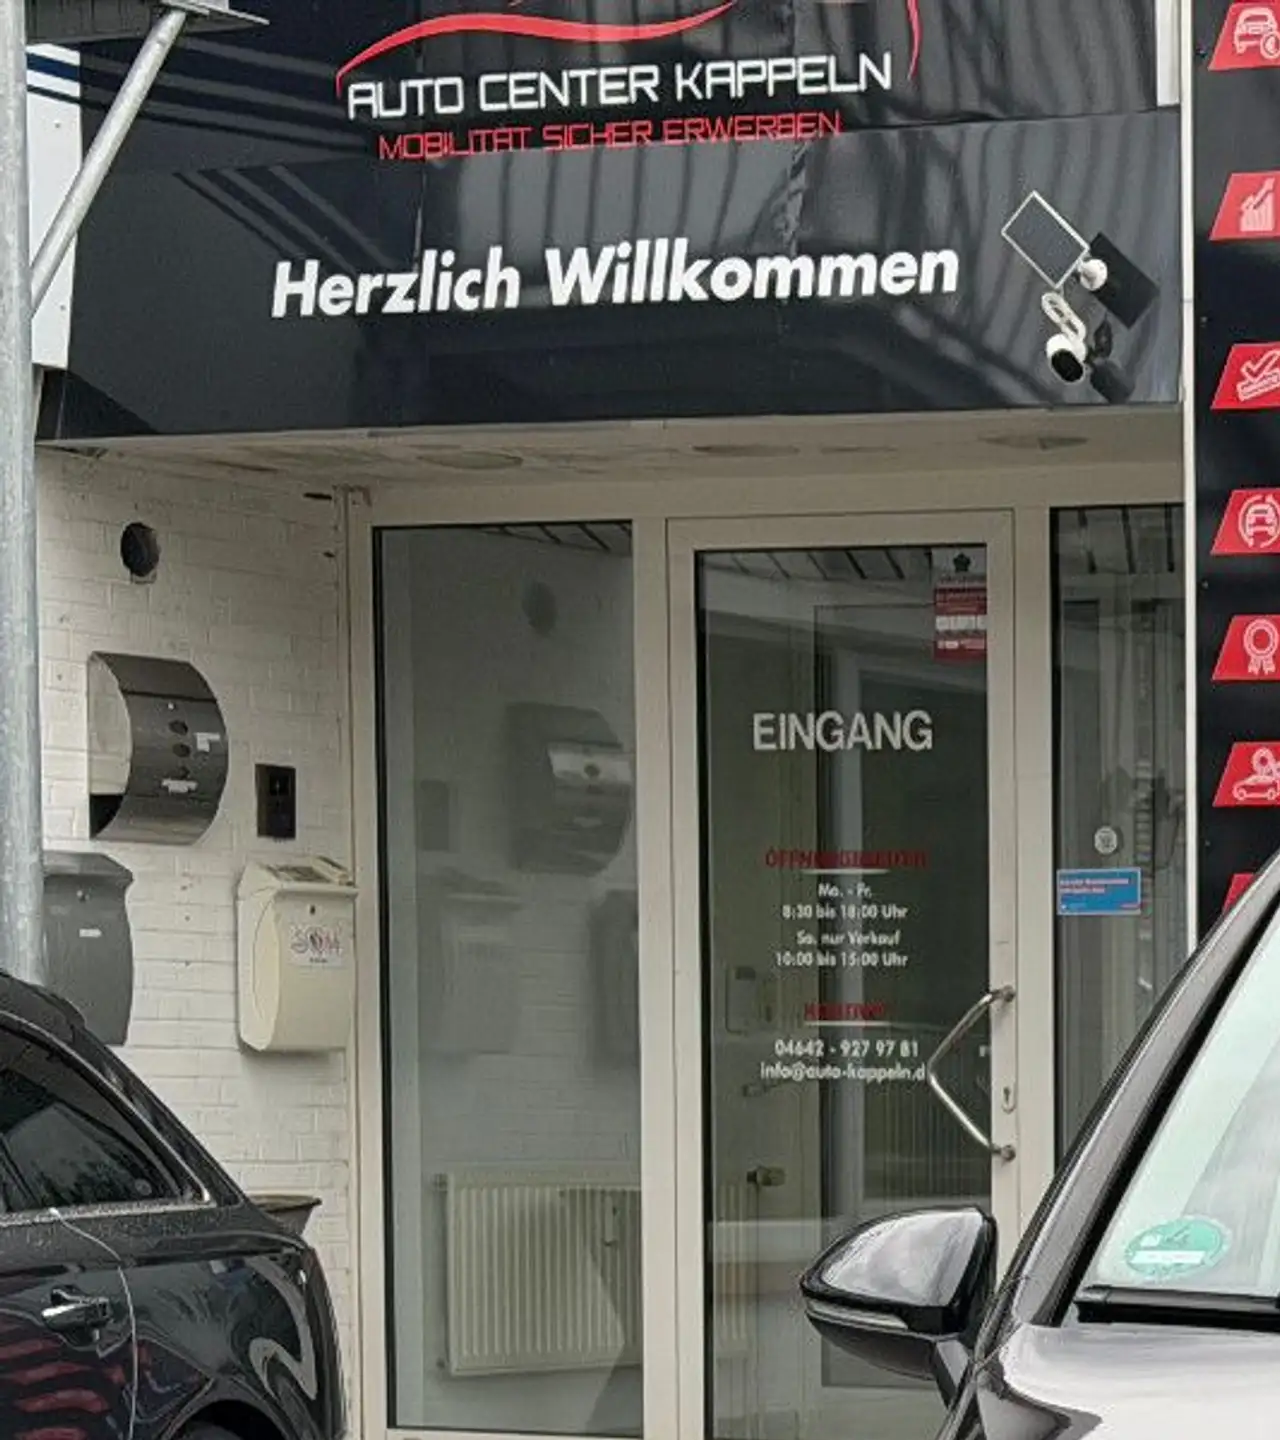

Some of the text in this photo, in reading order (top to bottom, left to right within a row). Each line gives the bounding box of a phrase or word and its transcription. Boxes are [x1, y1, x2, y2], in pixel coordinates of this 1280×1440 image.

[347, 52, 892, 120] AUTO CENTER KAPPELN
[541, 119, 652, 151] SICHER
[662, 109, 842, 146] ERWERBEN
[270, 237, 960, 318] Herzlich Willkommen
[753, 709, 934, 752] EINGANG
[881, 904, 908, 919] Uhr
[821, 934, 845, 946] nur
[848, 930, 902, 946] Verkauf
[882, 951, 909, 967] Uhr
[840, 1039, 870, 1058] 927
[876, 1039, 896, 1058] 97
[760, 1060, 926, 1084] info@auto-kappeln.d
